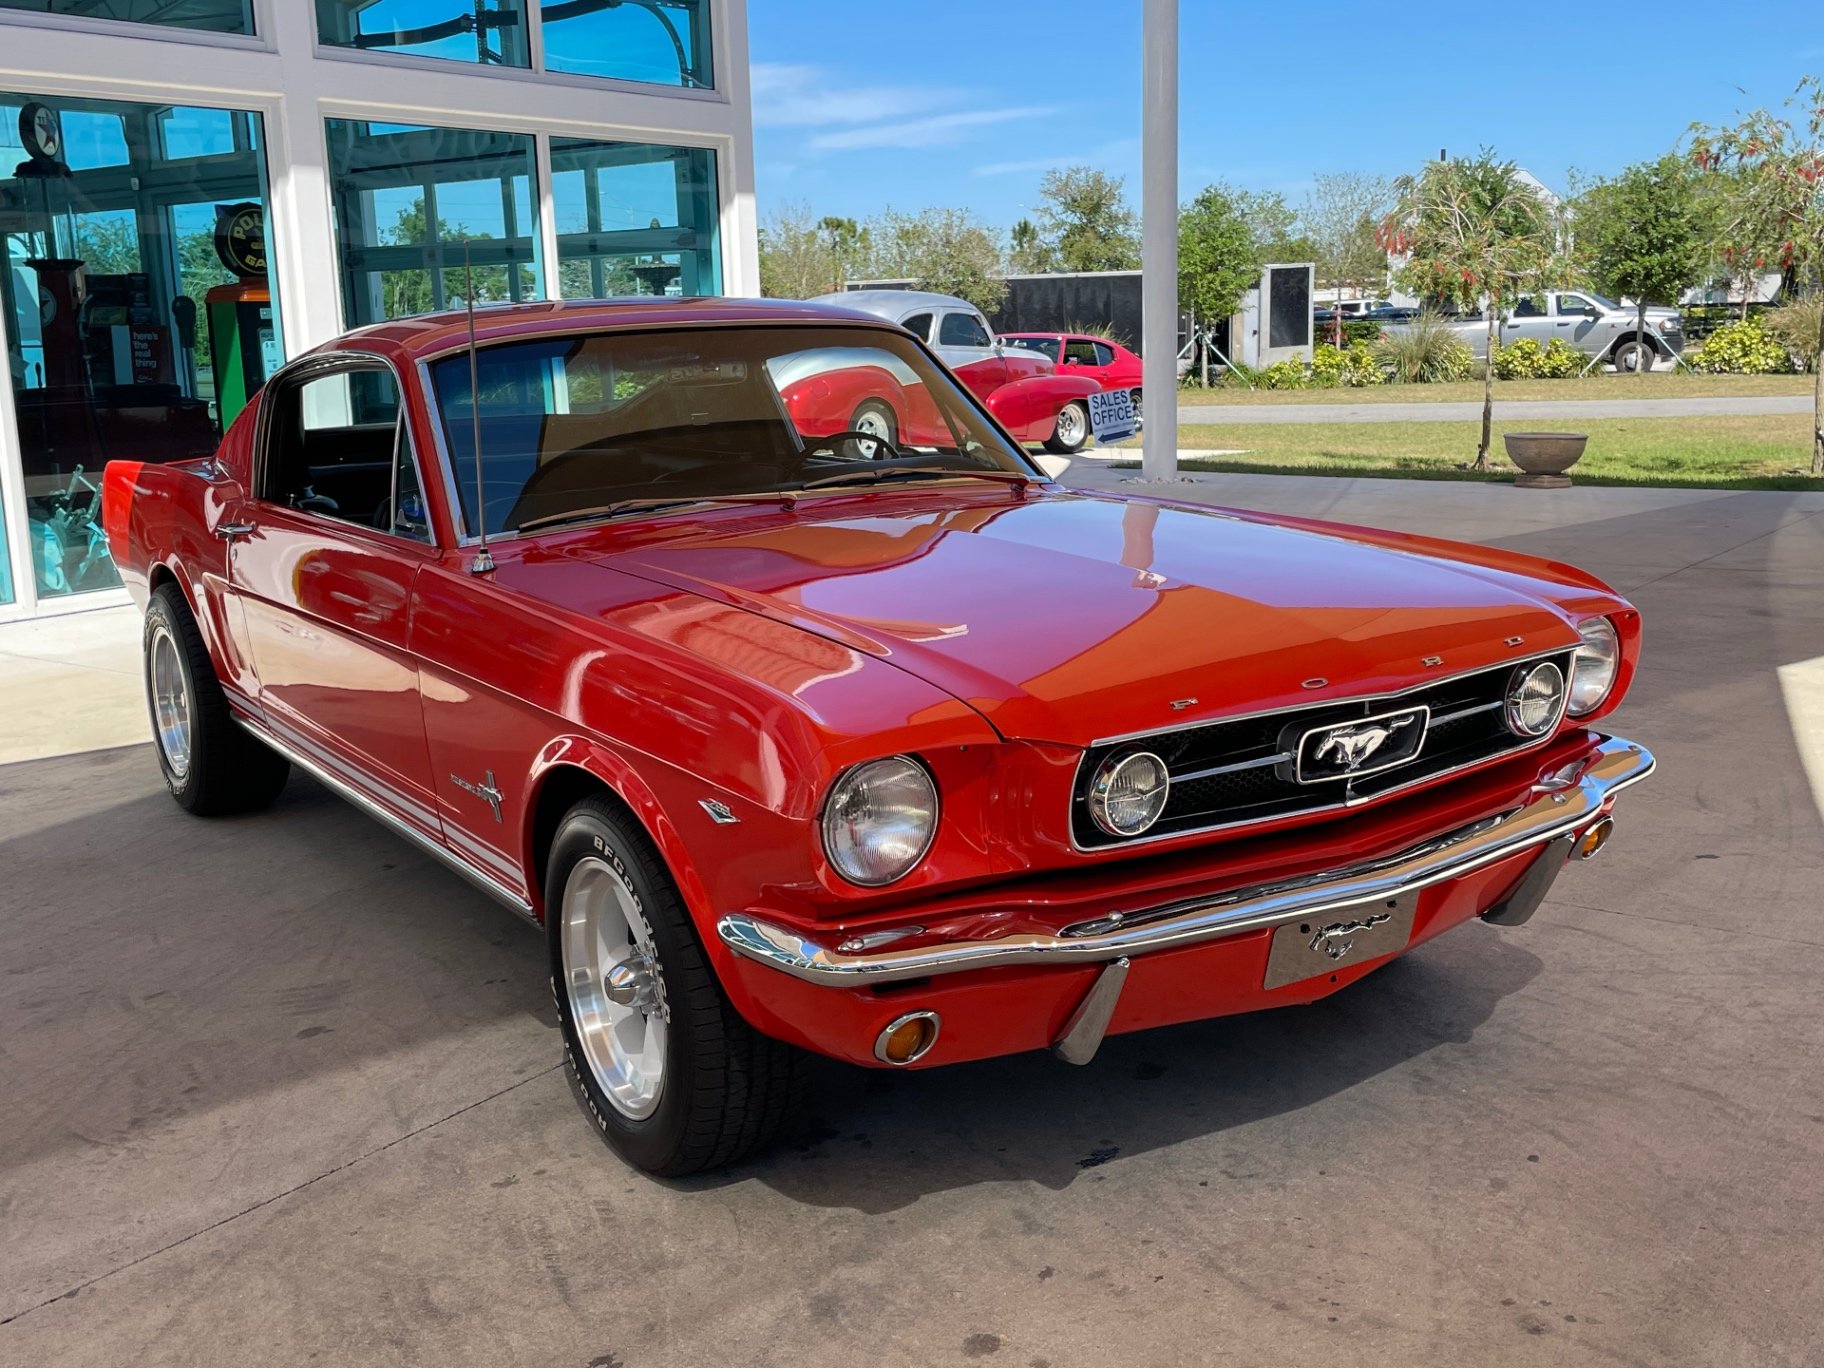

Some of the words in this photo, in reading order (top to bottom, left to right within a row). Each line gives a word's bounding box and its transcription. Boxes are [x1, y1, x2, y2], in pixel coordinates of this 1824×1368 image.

[233, 213, 264, 240] POL
[245, 254, 267, 268] GA
[134, 341, 149, 350] the
[135, 359, 157, 369] thing
[1092, 390, 1128, 410] SALES
[1093, 405, 1132, 426] OFFICE
[1169, 635, 1525, 711] FORD
